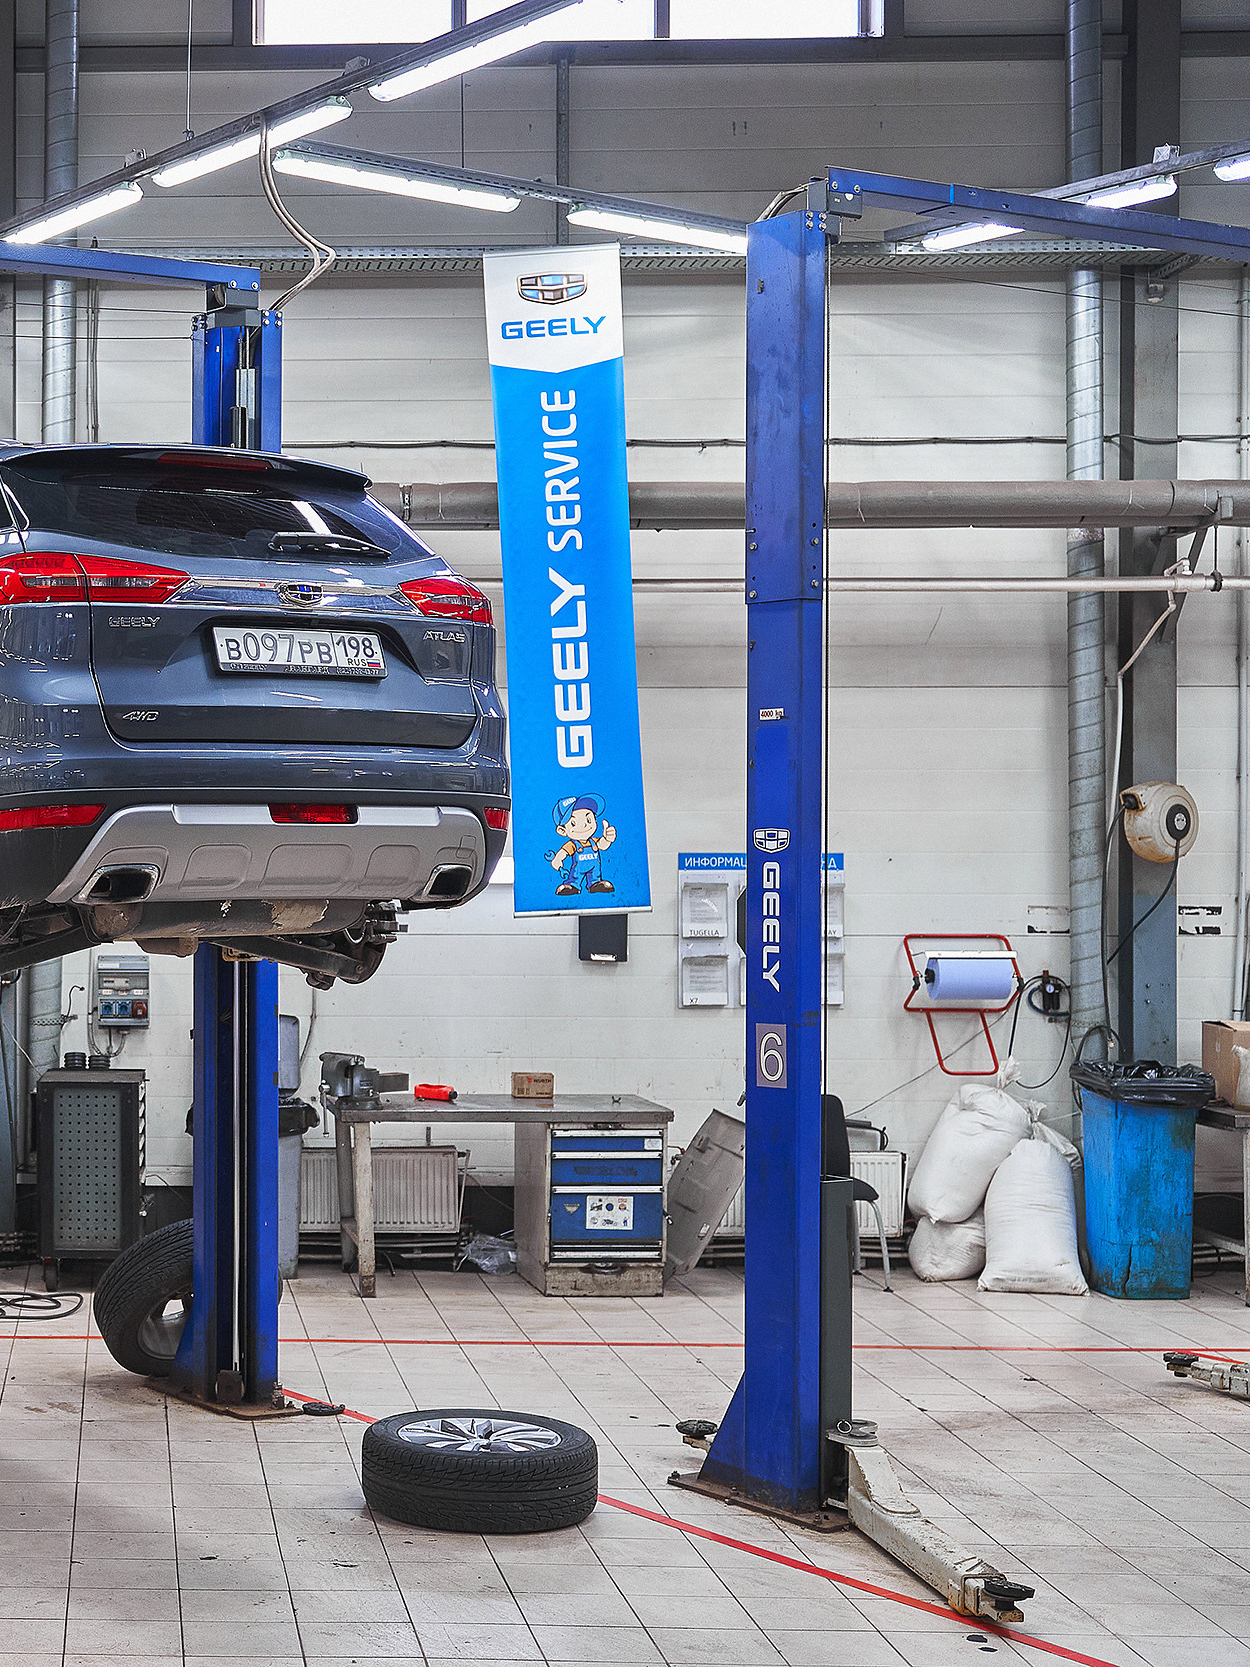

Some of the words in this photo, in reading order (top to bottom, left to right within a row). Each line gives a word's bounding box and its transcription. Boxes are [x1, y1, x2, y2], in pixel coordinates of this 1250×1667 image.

[500, 315, 607, 340] GEELY
[540, 388, 584, 551] SERVICE
[108, 616, 161, 628] GEELY
[422, 630, 466, 643] ATLAS
[347, 658, 367, 667] RUS
[547, 565, 594, 769] GEELY
[689, 929, 720, 937] TUGELLA
[762, 861, 781, 993] GEELY
[759, 1031, 785, 1082] 6
